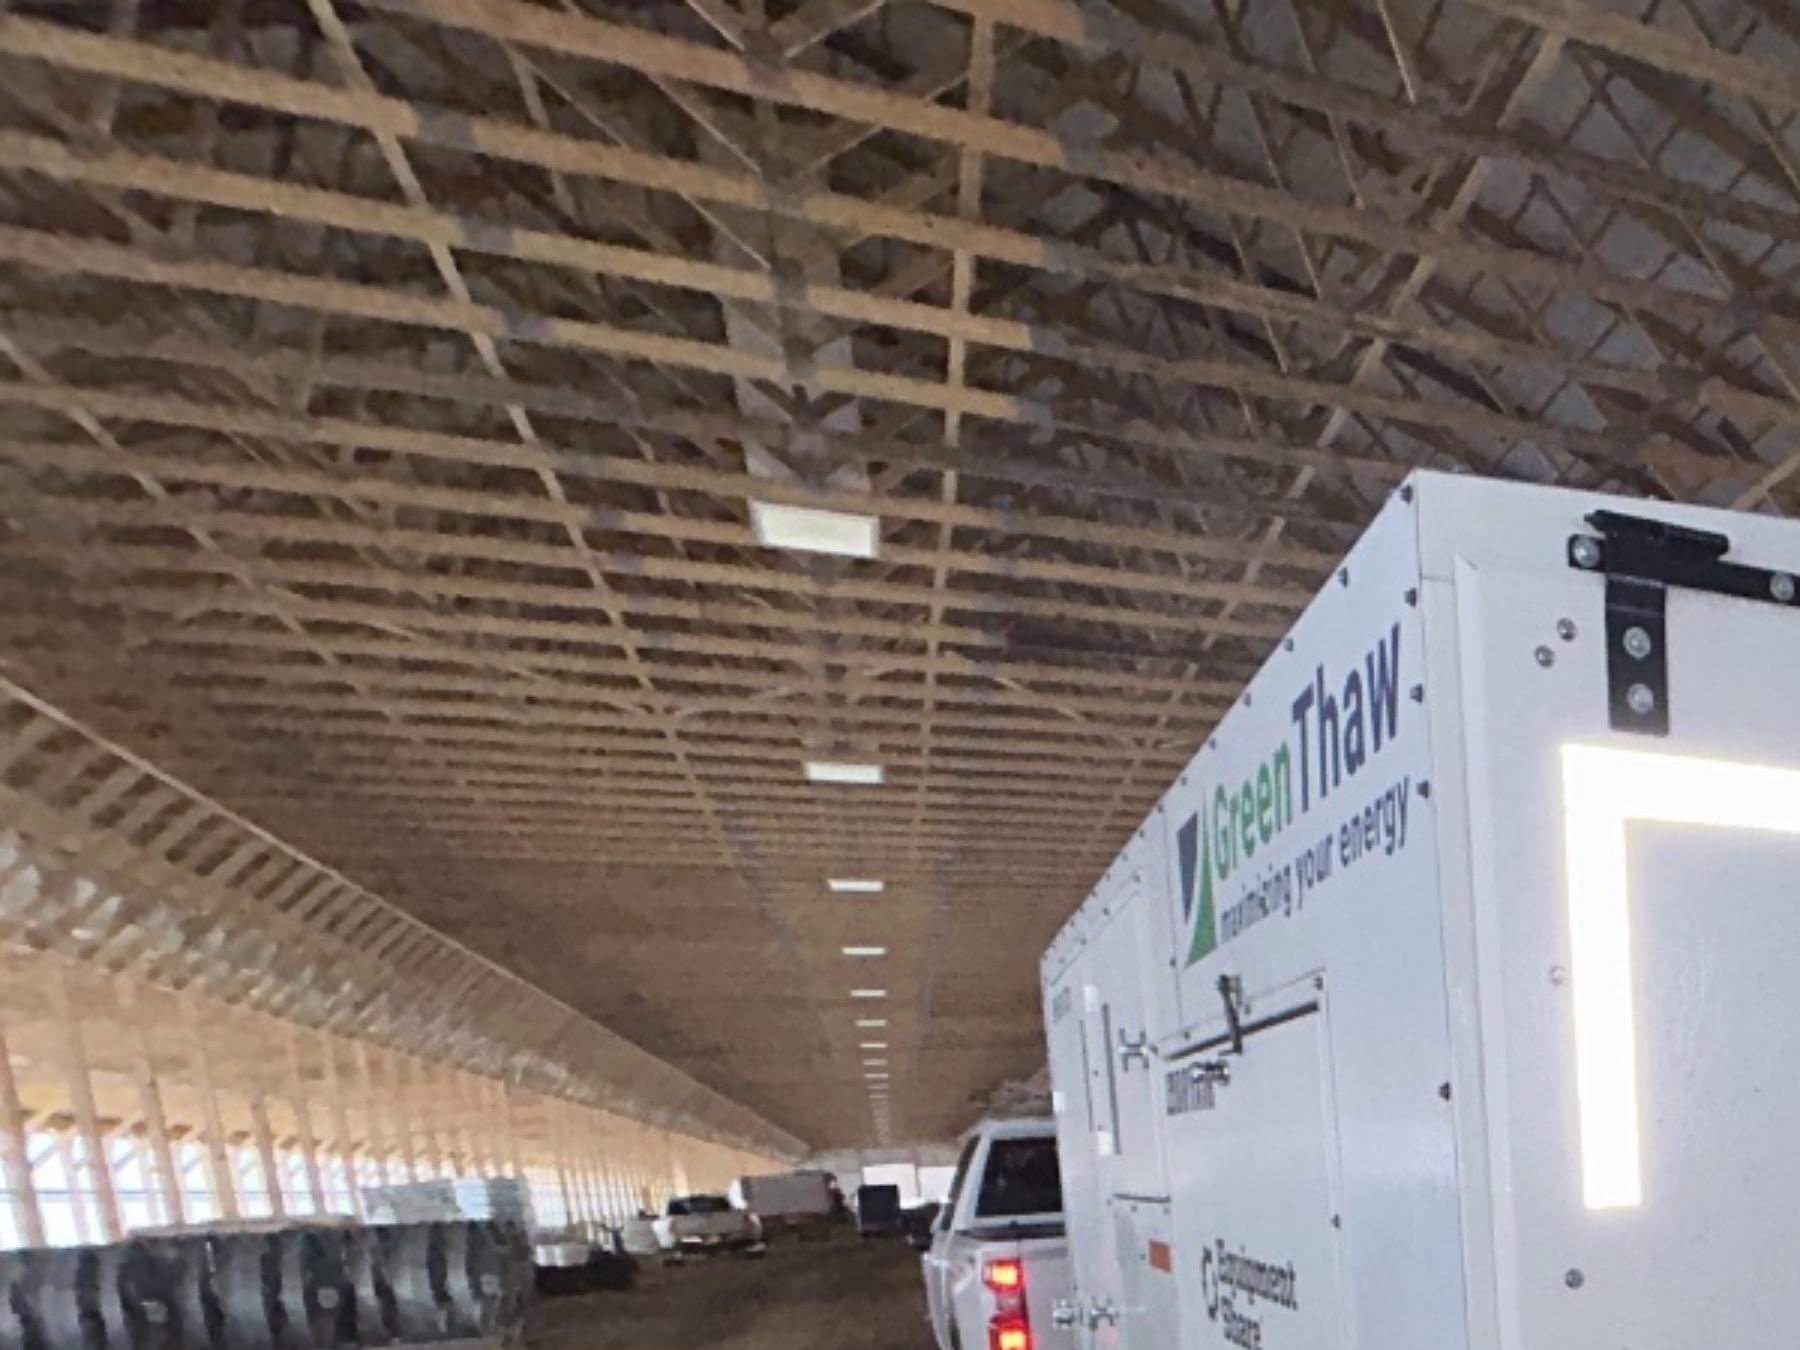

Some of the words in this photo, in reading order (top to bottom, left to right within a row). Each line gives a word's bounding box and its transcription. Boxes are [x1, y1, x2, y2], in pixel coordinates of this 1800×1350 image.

[1214, 621, 1400, 881] GreenThaw
[1295, 833, 1334, 911] your
[1340, 775, 1410, 868] energy
